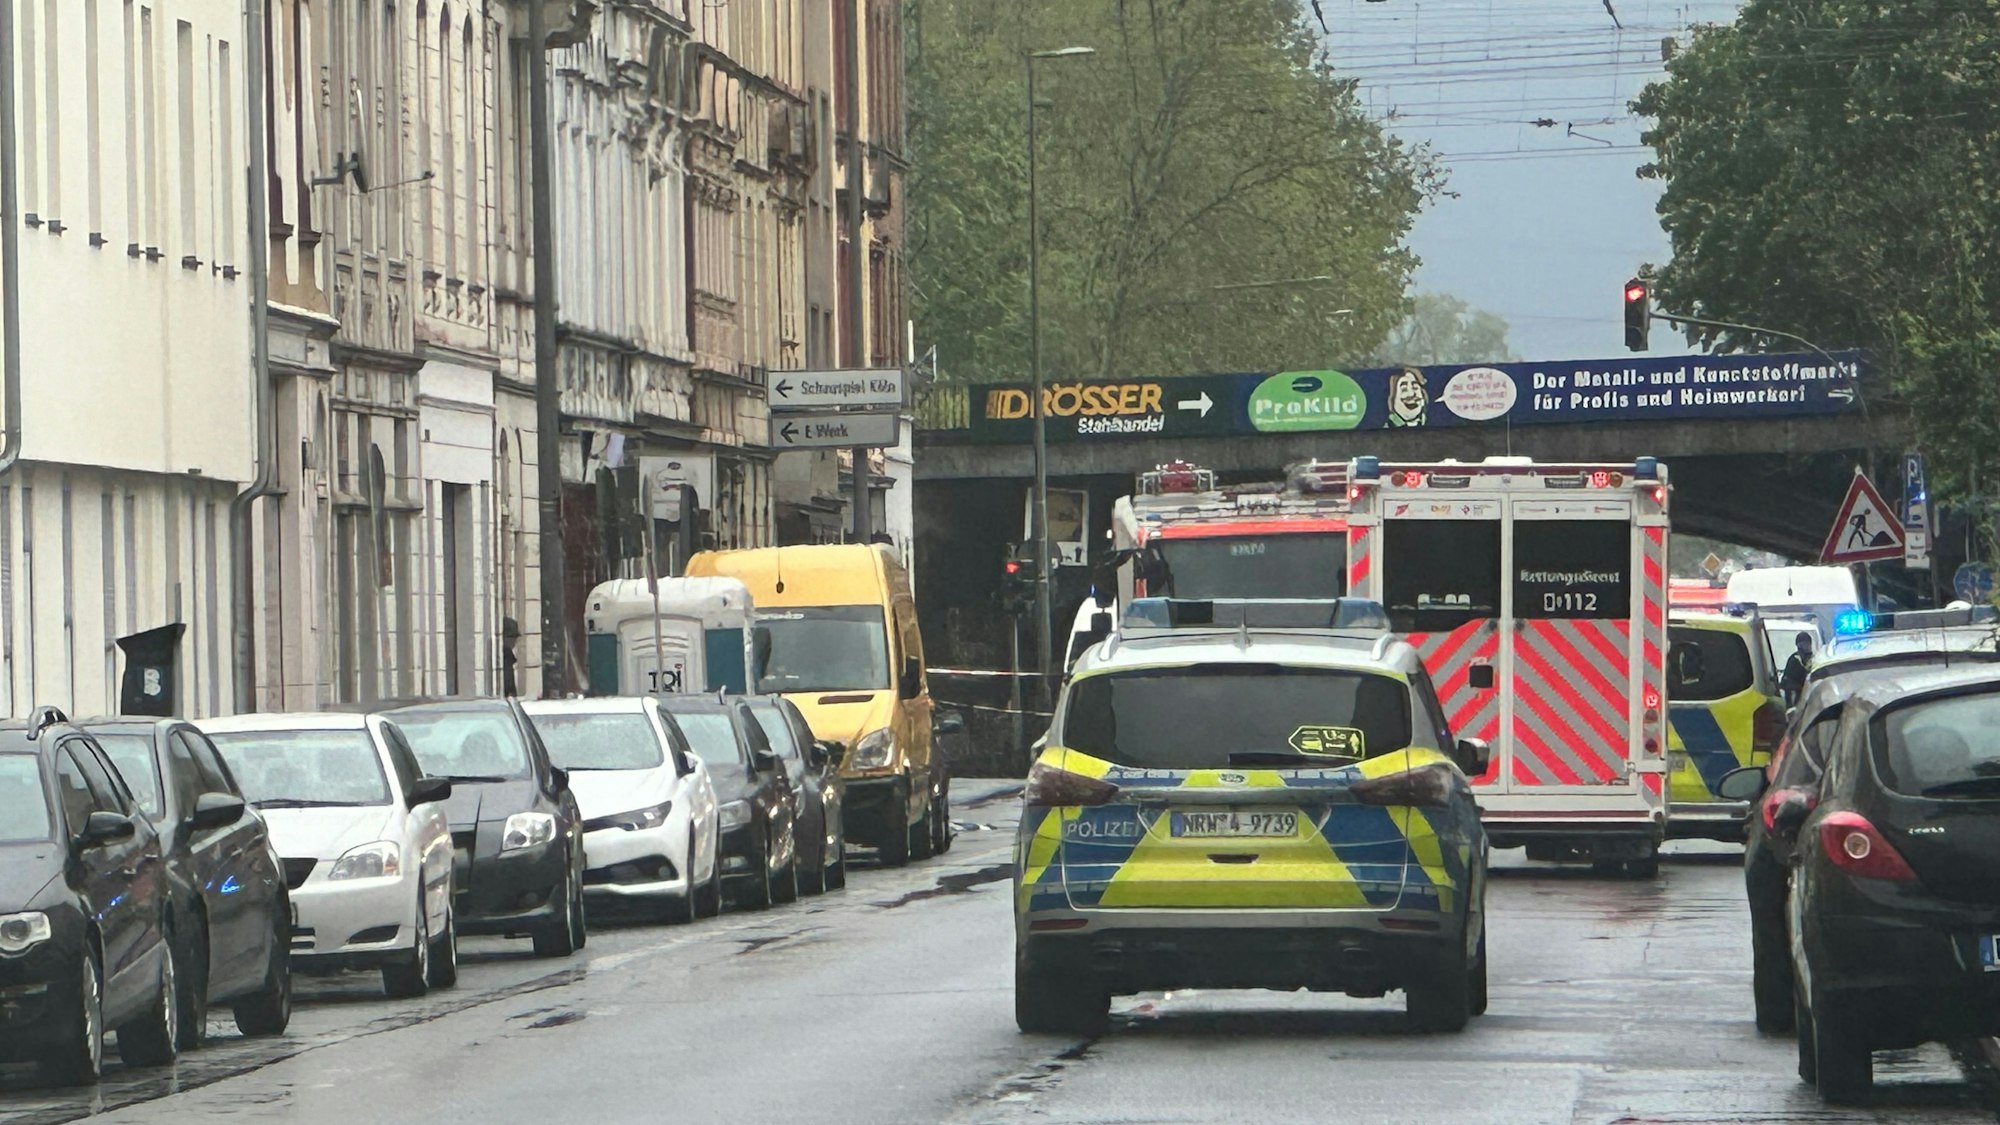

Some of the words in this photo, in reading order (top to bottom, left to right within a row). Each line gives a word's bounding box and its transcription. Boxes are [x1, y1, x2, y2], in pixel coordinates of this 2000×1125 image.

[1651, 367, 1685, 385] und
[1534, 393, 1562, 411] für
[1570, 391, 1629, 409] Profis
[1637, 390, 1672, 407] und
[1564, 592, 1597, 611] 112
[1066, 820, 1139, 837] POLIZEI
[1183, 813, 1217, 835] NRW
